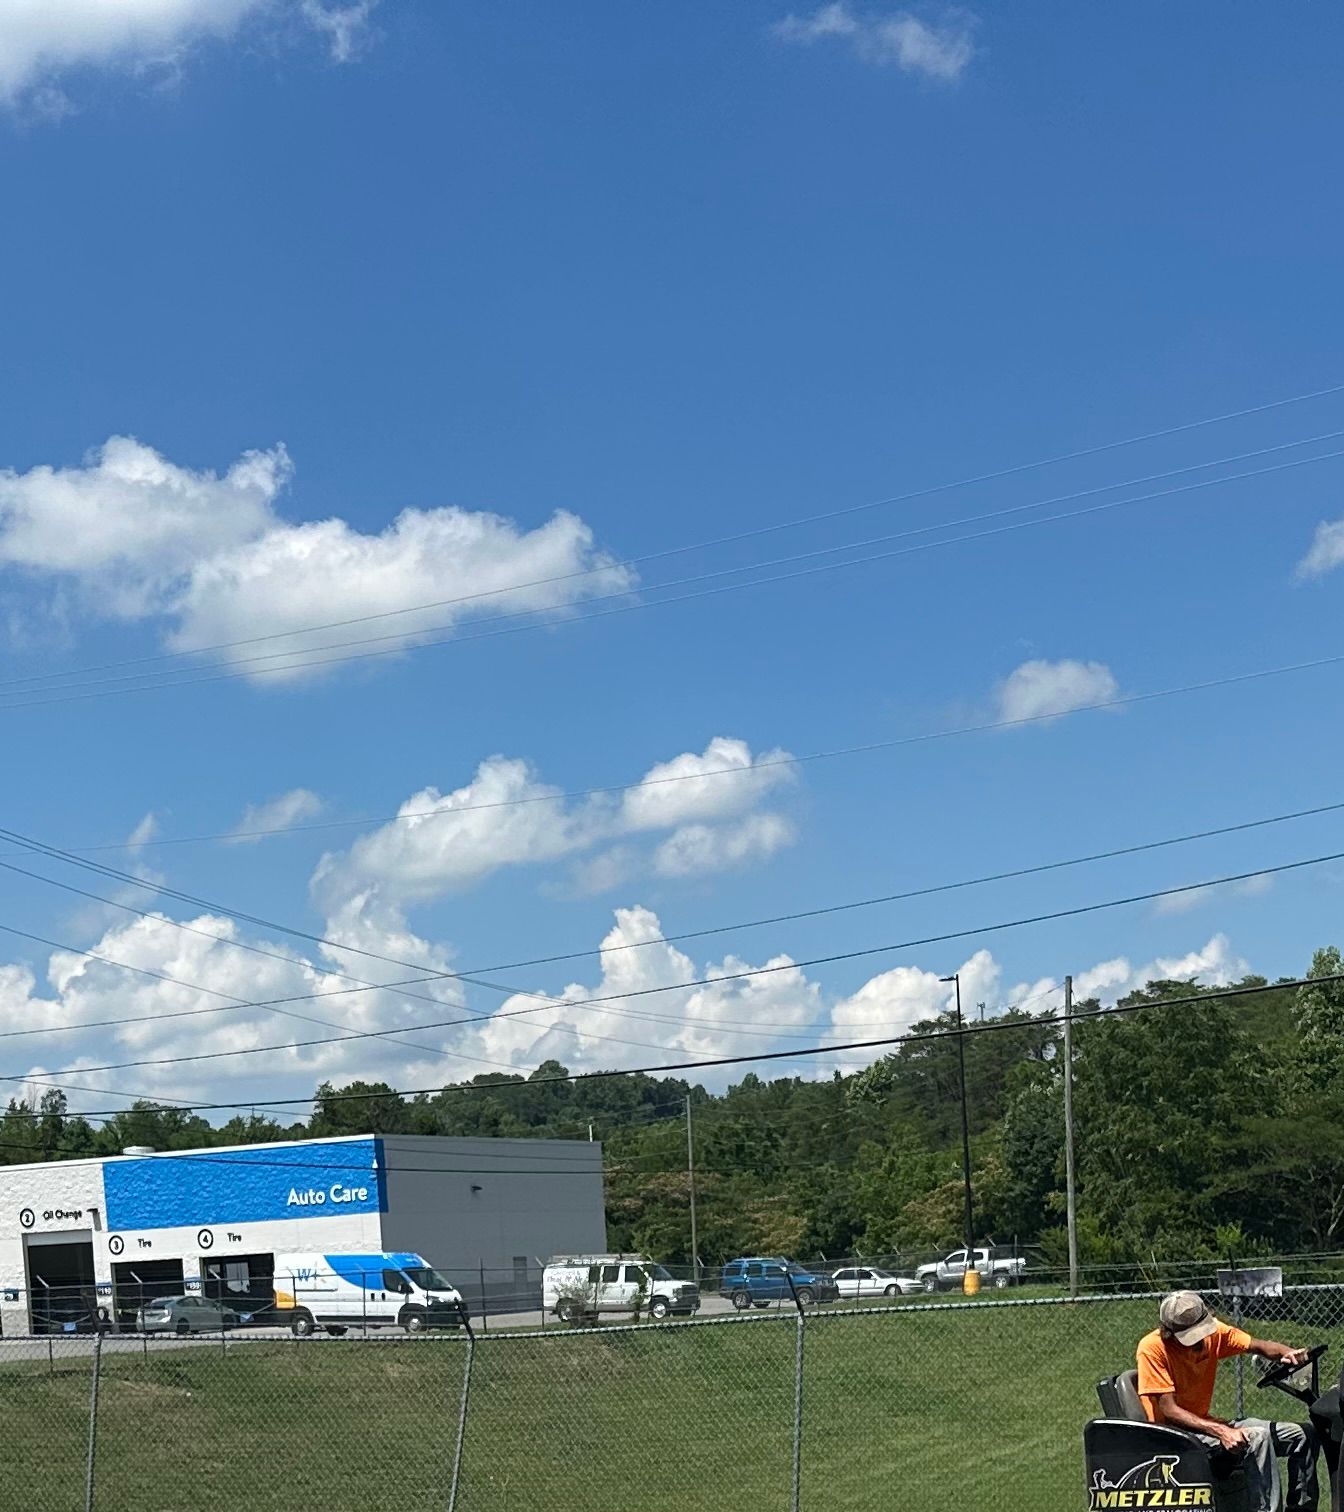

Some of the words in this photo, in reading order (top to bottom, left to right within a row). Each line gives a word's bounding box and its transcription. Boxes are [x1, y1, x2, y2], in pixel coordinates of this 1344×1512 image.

[287, 1187, 326, 1206] Auto
[329, 1184, 368, 1203] Care
[43, 1210, 53, 1220] Oil
[55, 1209, 83, 1221] Change
[138, 1238, 152, 1248] Tire
[227, 1233, 242, 1243] Tire
[1096, 1488, 1212, 1508] METZLER
